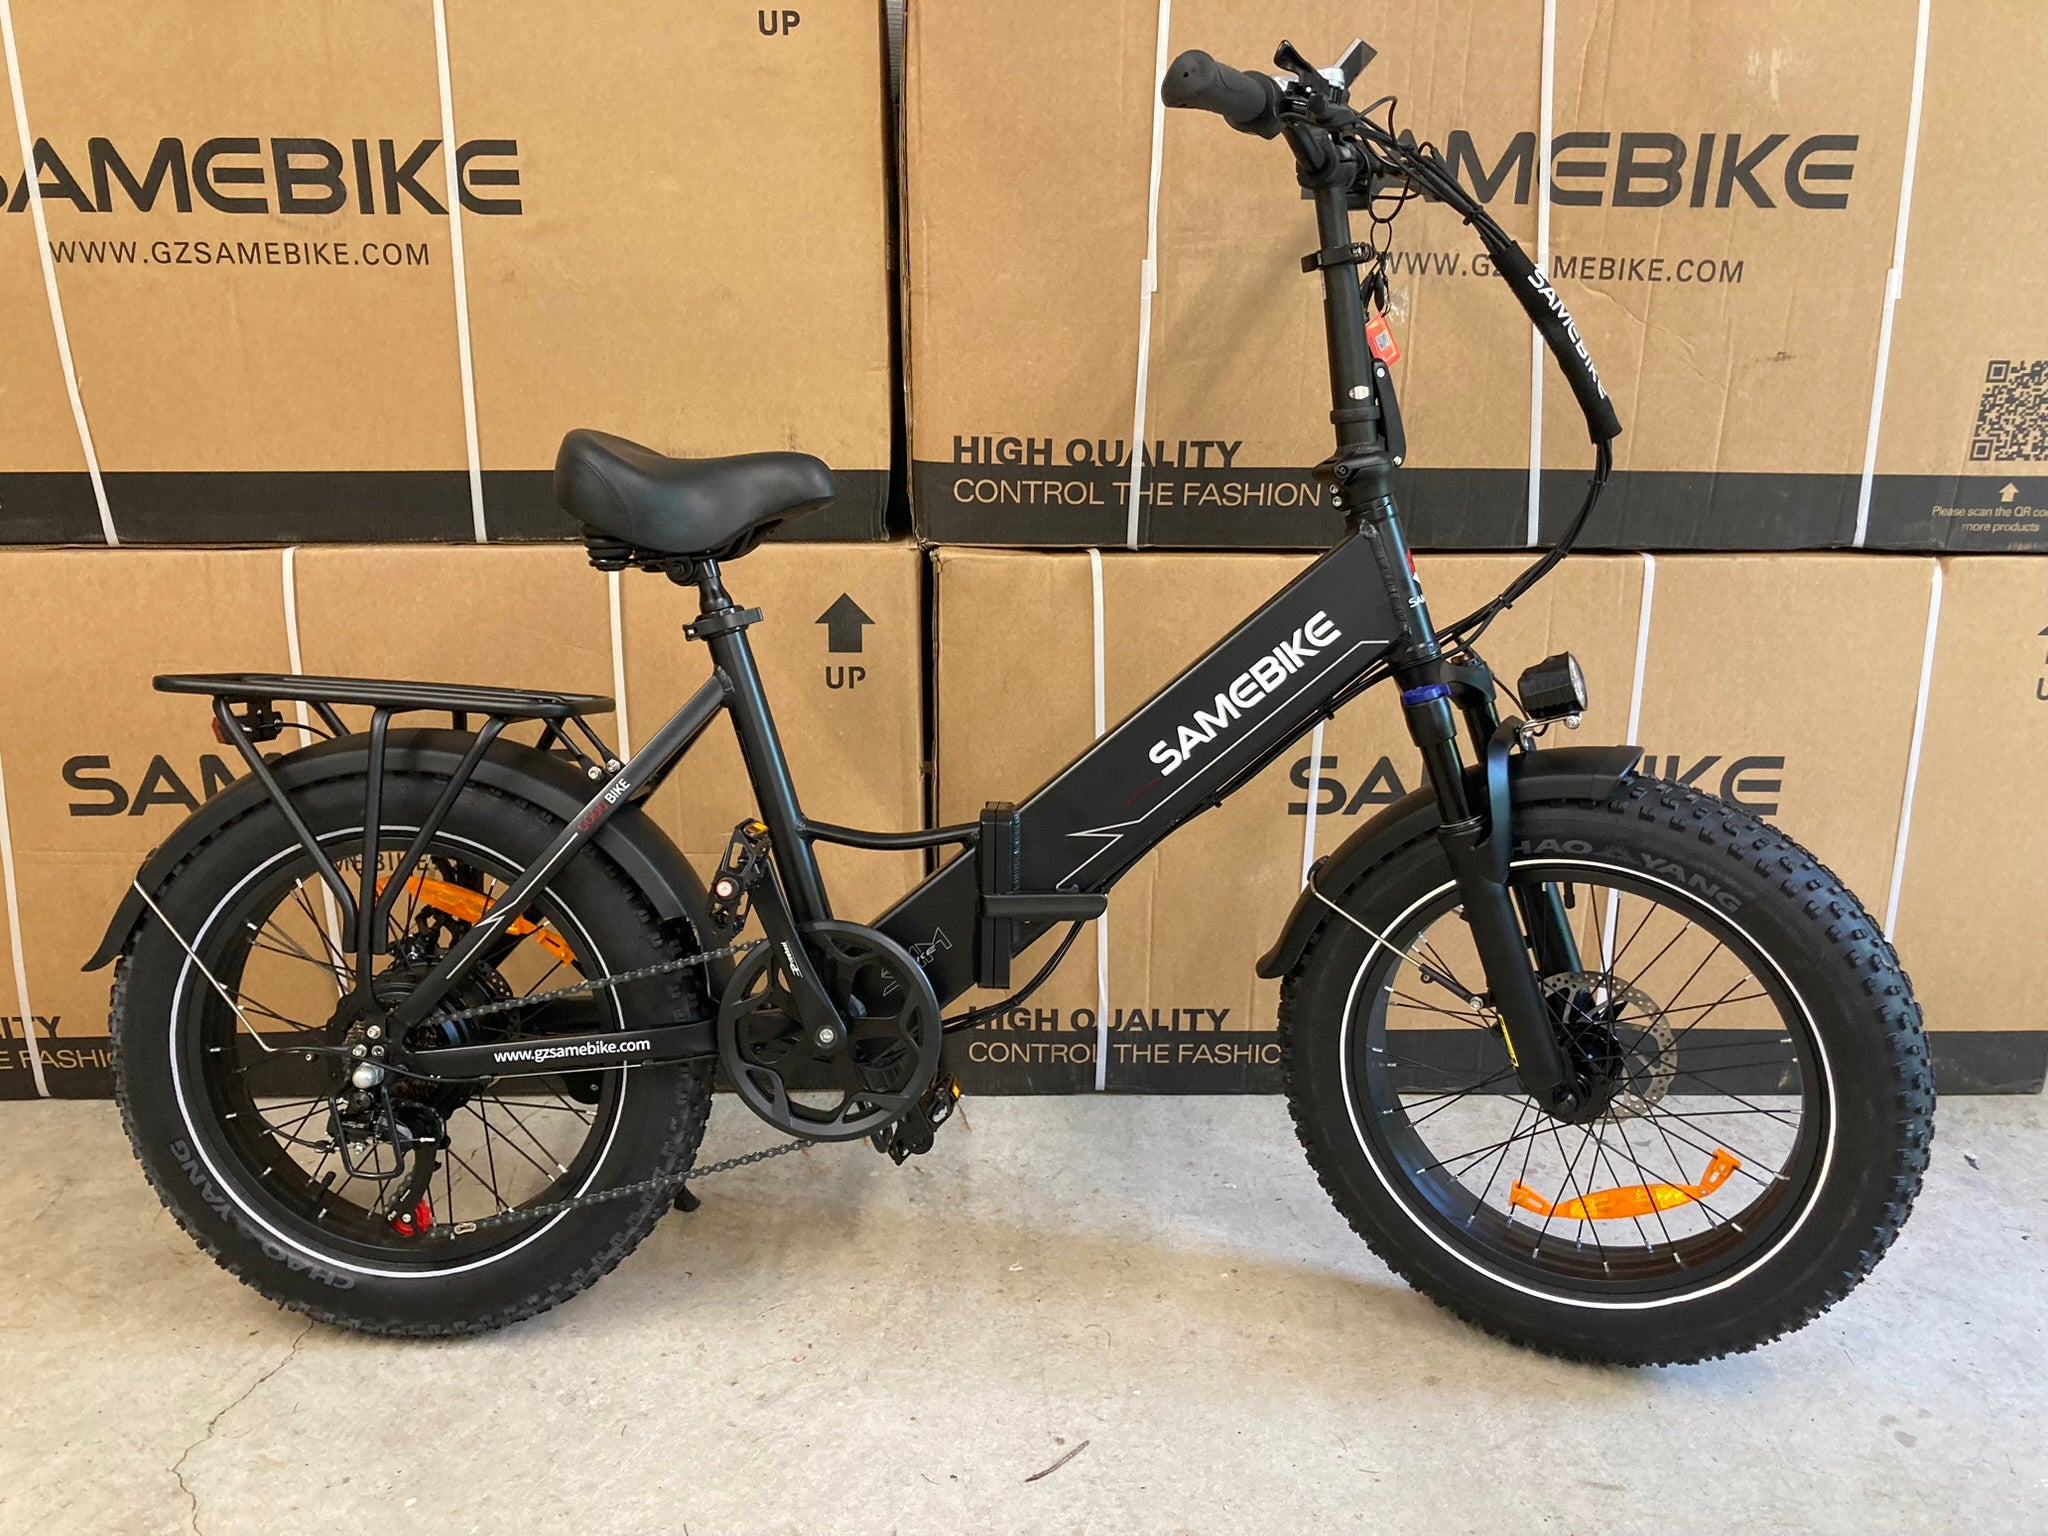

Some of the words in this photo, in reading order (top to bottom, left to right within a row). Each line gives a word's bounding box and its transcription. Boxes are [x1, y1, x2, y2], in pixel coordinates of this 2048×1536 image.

[758, 10, 801, 35] UP
[0, 137, 522, 215] AMEBIKE
[49, 241, 430, 266] WWW.GZSAMEBIKE.COM
[1385, 252, 1745, 284] WWW.GMEBIKE.COM
[953, 435, 1053, 466] HIGH
[1065, 438, 1244, 468] QUALITY
[953, 478, 1105, 505] CONTROL
[1112, 482, 1174, 505] THE
[1183, 483, 1321, 507] FASHION
[1932, 505, 1965, 517] Please
[1967, 507, 1992, 517] scan
[1995, 506, 2012, 517] the
[2014, 506, 2031, 518] QR
[1962, 523, 1990, 532] more
[1992, 521, 2040, 534] products
[825, 665, 866, 690] UP
[1148, 610, 1342, 777] SAMEBIKE
[604, 778, 630, 804] BIKE
[1511, 839, 1593, 855] HAO
[1639, 852, 1743, 913] YANG
[493, 1039, 651, 1063] www.gzsamebike.com
[1113, 1043, 1169, 1064] THE
[169, 1138, 232, 1223] YANG
[261, 1240, 356, 1290] CHAO
